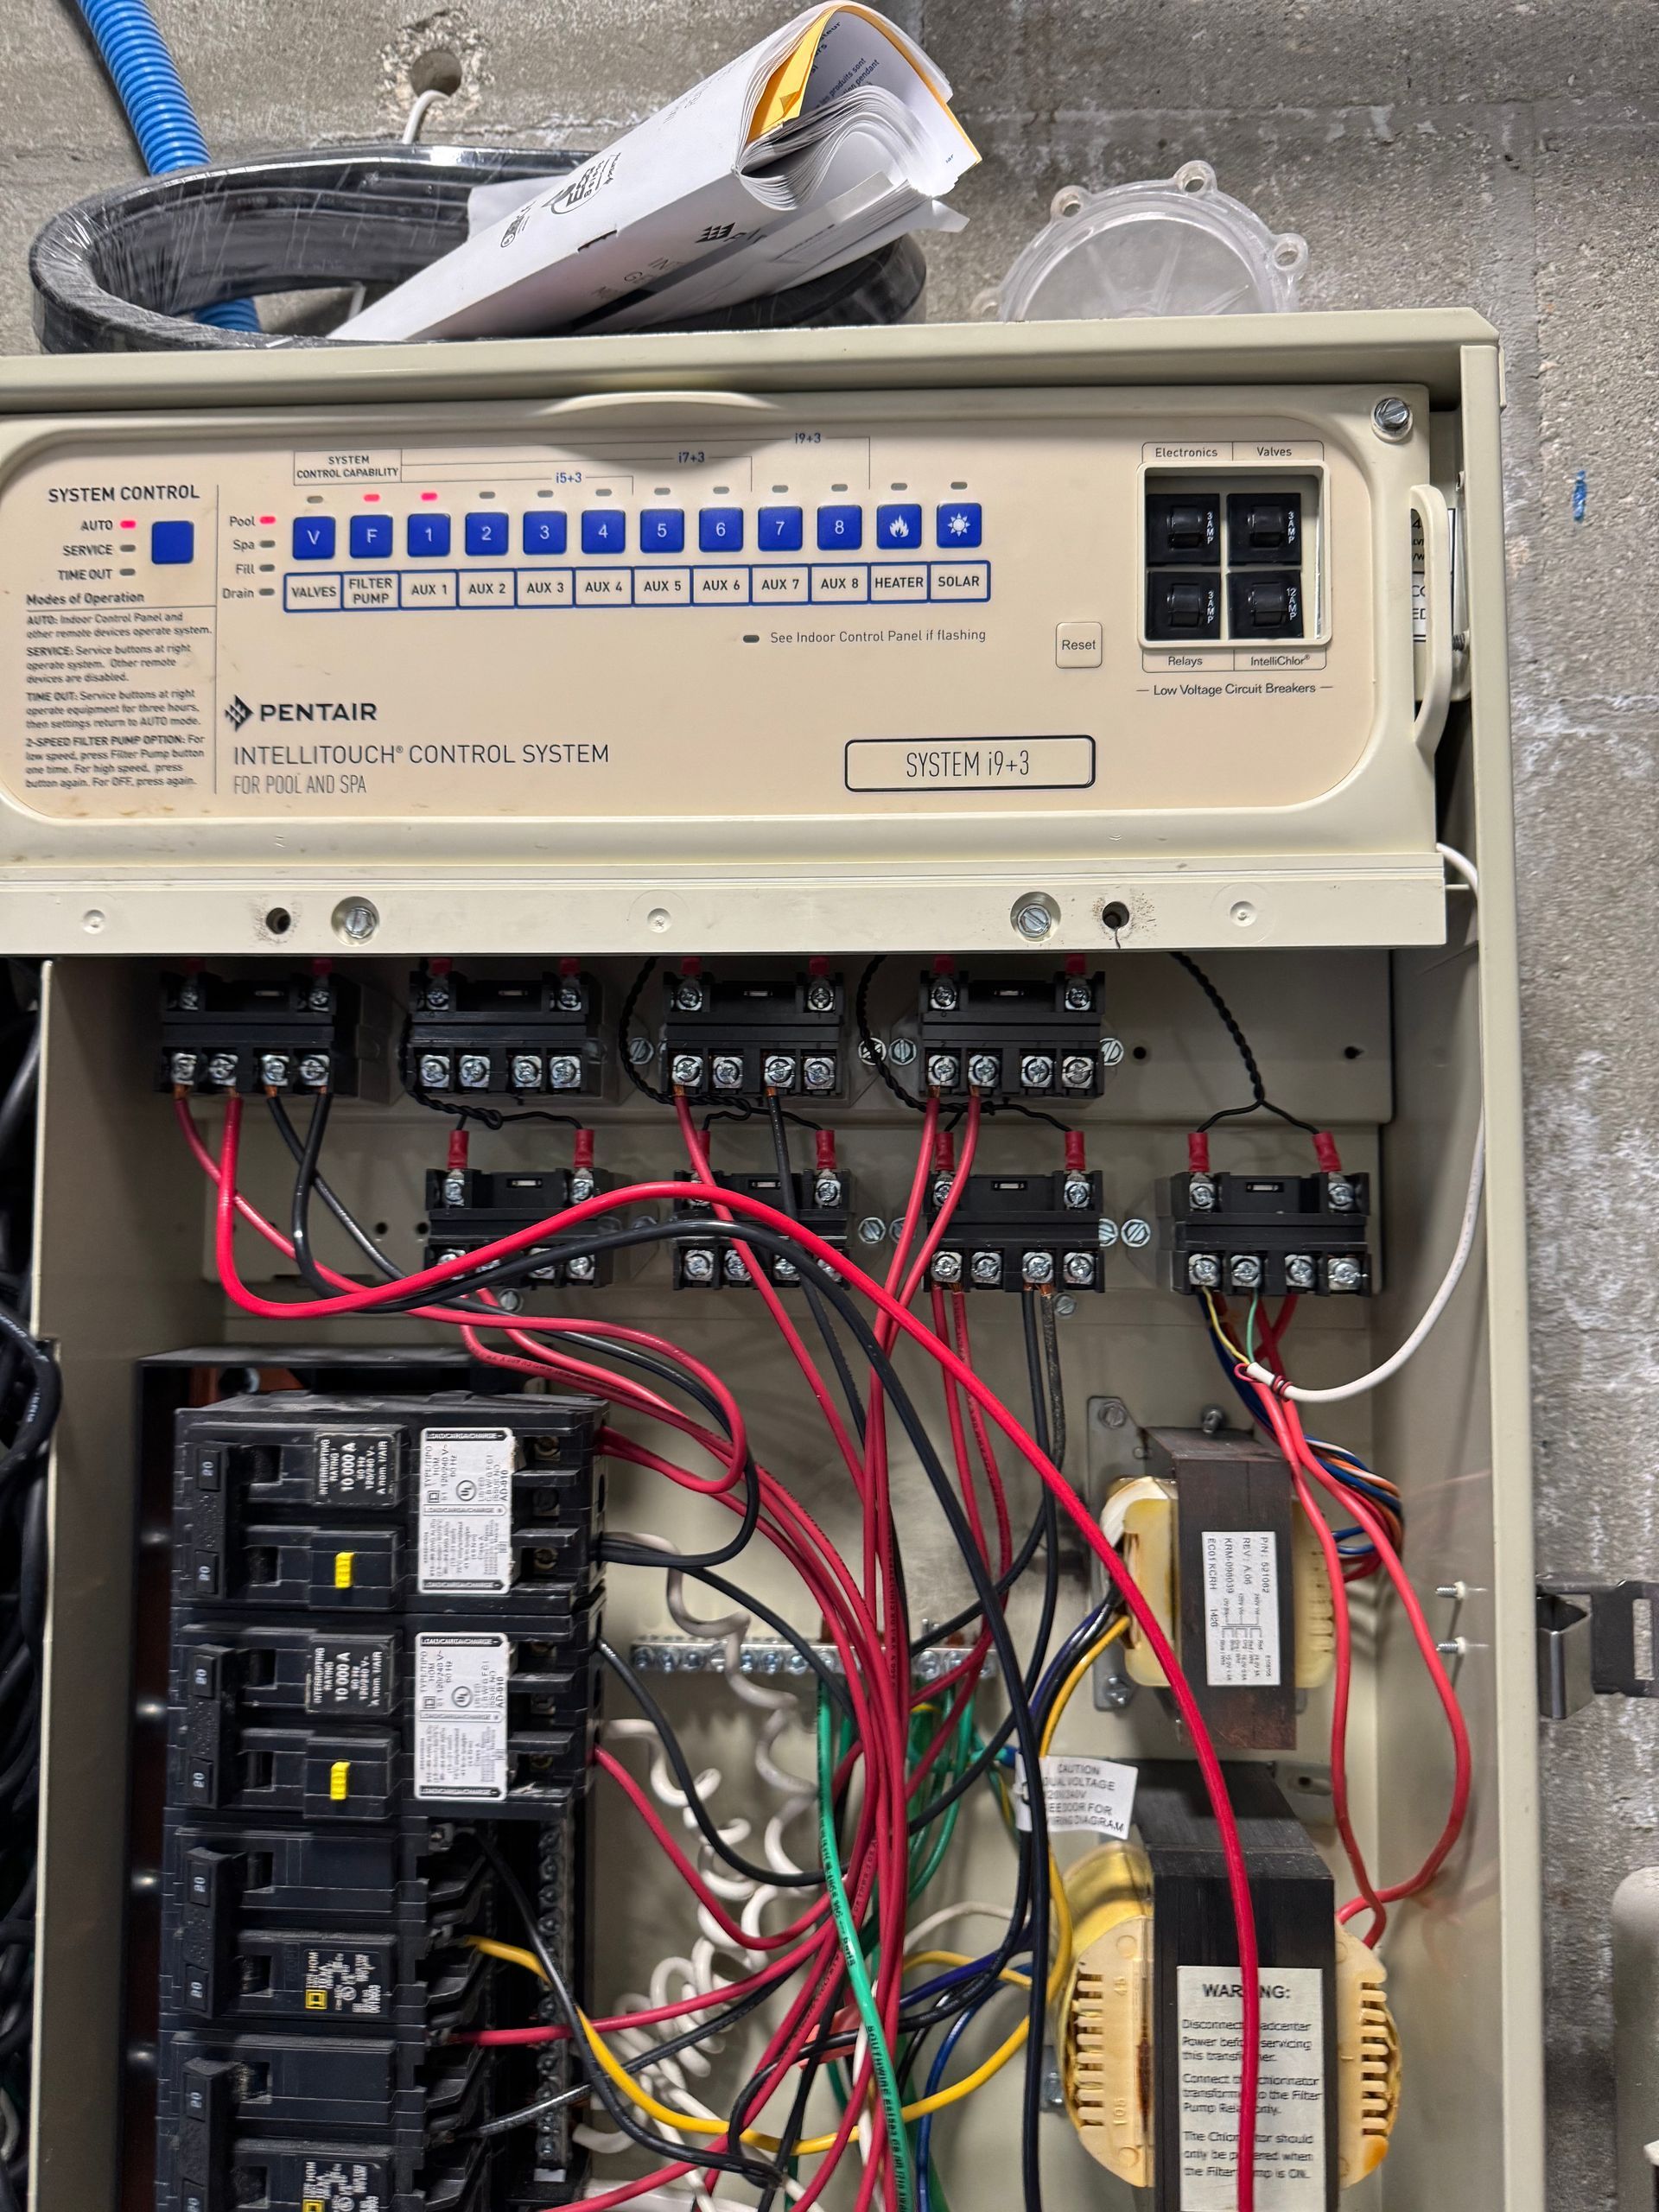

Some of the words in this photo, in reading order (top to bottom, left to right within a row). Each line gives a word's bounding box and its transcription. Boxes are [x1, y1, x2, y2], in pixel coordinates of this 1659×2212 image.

[830, 71, 853, 97] produits
[852, 58, 867, 74] sont
[855, 60, 880, 86] pendant
[794, 433, 822, 444] i9+3
[678, 452, 705, 464] i7+3
[1154, 447, 1218, 458] Electronics
[1256, 446, 1292, 457] Valves
[328, 455, 370, 465] SYSTEM
[296, 468, 341, 479] CONTROL
[343, 467, 398, 478] CAPABILITY
[556, 472, 582, 483] i5+3
[48, 486, 115, 502] SYSTEM
[120, 485, 200, 499] CONTROL
[81, 520, 112, 531] AUTO
[229, 516, 255, 527] Pool
[835, 520, 844, 535] 8
[424, 528, 432, 542] 1
[481, 526, 492, 541] 2
[540, 525, 550, 540] 3
[598, 524, 608, 538] 4
[657, 523, 667, 537] 5
[715, 522, 726, 537] 6
[775, 521, 785, 536] 7
[308, 531, 320, 545] V
[367, 529, 378, 543] F
[63, 544, 112, 556] SERVICE
[233, 539, 255, 551] Spa
[59, 569, 87, 580] TIME
[89, 569, 112, 580] OUT
[236, 563, 255, 575] Fill
[349, 577, 393, 590] FILTER
[526, 582, 552, 594] AUX
[556, 582, 564, 594] 3
[585, 581, 610, 593] AUX
[614, 581, 622, 592] 4
[644, 580, 670, 592] AUX
[674, 580, 682, 591] 5
[702, 579, 728, 591] AUX
[733, 579, 741, 590] 6
[761, 578, 787, 590] AUX
[791, 578, 799, 589] 7
[821, 578, 847, 589] AUX
[850, 577, 859, 589] 8
[874, 576, 924, 588] HEATER
[938, 575, 980, 588] SOLAR
[223, 588, 254, 599] Drain
[291, 587, 337, 598] VALVES
[410, 584, 437, 595] AUX
[442, 584, 448, 595] 1
[468, 583, 494, 595] AUX
[499, 583, 506, 594] 2
[27, 594, 66, 606] Modes
[68, 594, 81, 604] of
[84, 592, 144, 606] Operation
[353, 592, 390, 605] PUMP
[27, 615, 58, 625] AUTO:
[60, 614, 93, 624] Indoor
[94, 613, 130, 623] Control
[134, 613, 162, 622] Panel
[165, 612, 183, 621] and
[55, 629, 92, 638] remote
[93, 628, 130, 637] devices
[133, 627, 171, 638] operate
[174, 626, 212, 636] system.
[770, 632, 794, 644] See
[797, 632, 836, 643] Indoor
[839, 631, 884, 642] Control
[888, 630, 923, 641] Panel
[925, 629, 933, 641] if
[937, 629, 986, 643] flashing
[27, 646, 73, 657] SERVICE:
[75, 645, 112, 655] Service
[115, 645, 152, 654] buttons
[155, 645, 164, 653] at
[167, 644, 191, 655] right
[1062, 639, 1096, 651] Reset
[27, 661, 64, 671] operate
[110, 658, 138, 668] Other
[141, 658, 176, 667] remote
[1168, 655, 1203, 667] Relays
[27, 675, 63, 683] devices
[66, 675, 82, 683] are
[84, 673, 130, 683] disabled.
[27, 692, 51, 702] TIME
[79, 690, 117, 701] Service
[119, 690, 156, 700] buttons
[159, 690, 169, 699] at
[171, 689, 195, 700] right
[1154, 684, 1176, 696] Low
[1180, 683, 1222, 696] Voltage
[1225, 683, 1262, 694] Circuit
[1266, 682, 1316, 694] Breakers
[260, 703, 378, 721] PENTAIR
[26, 737, 71, 747] 2-SPEED
[73, 736, 108, 746] FILTER
[111, 736, 142, 745] PUMP
[143, 735, 185, 745] OPTION:
[188, 734, 205, 744] For
[409, 745, 515, 764] CONTROL
[523, 744, 609, 763] SYSTEM
[906, 752, 979, 777] SYSTEM
[988, 750, 1029, 775] i9+3
[234, 776, 260, 794] FOR
[266, 776, 303, 794] POOL
[307, 775, 334, 793] AND
[340, 775, 366, 793] SPA
[319, 1439, 330, 1495] INTERRUPTING
[329, 1452, 340, 1481] RATING
[341, 1454, 355, 1476] 000
[340, 1478, 355, 1492] 10
[336, 1652, 351, 1662] A
[314, 1647, 325, 1704] INTERRUPTING
[324, 1662, 334, 1691] RATING
[335, 1664, 350, 1685] 000
[335, 1688, 349, 1701] 10
[1058, 1764, 1100, 1775] CAUTION
[1203, 1984, 1290, 1999] WARNG:
[1183, 2037, 1217, 2046] Power
[1261, 2039, 1312, 2050] servicing
[1292, 2090, 1323, 2101] Filter
[1184, 2102, 1216, 2113] Pump
